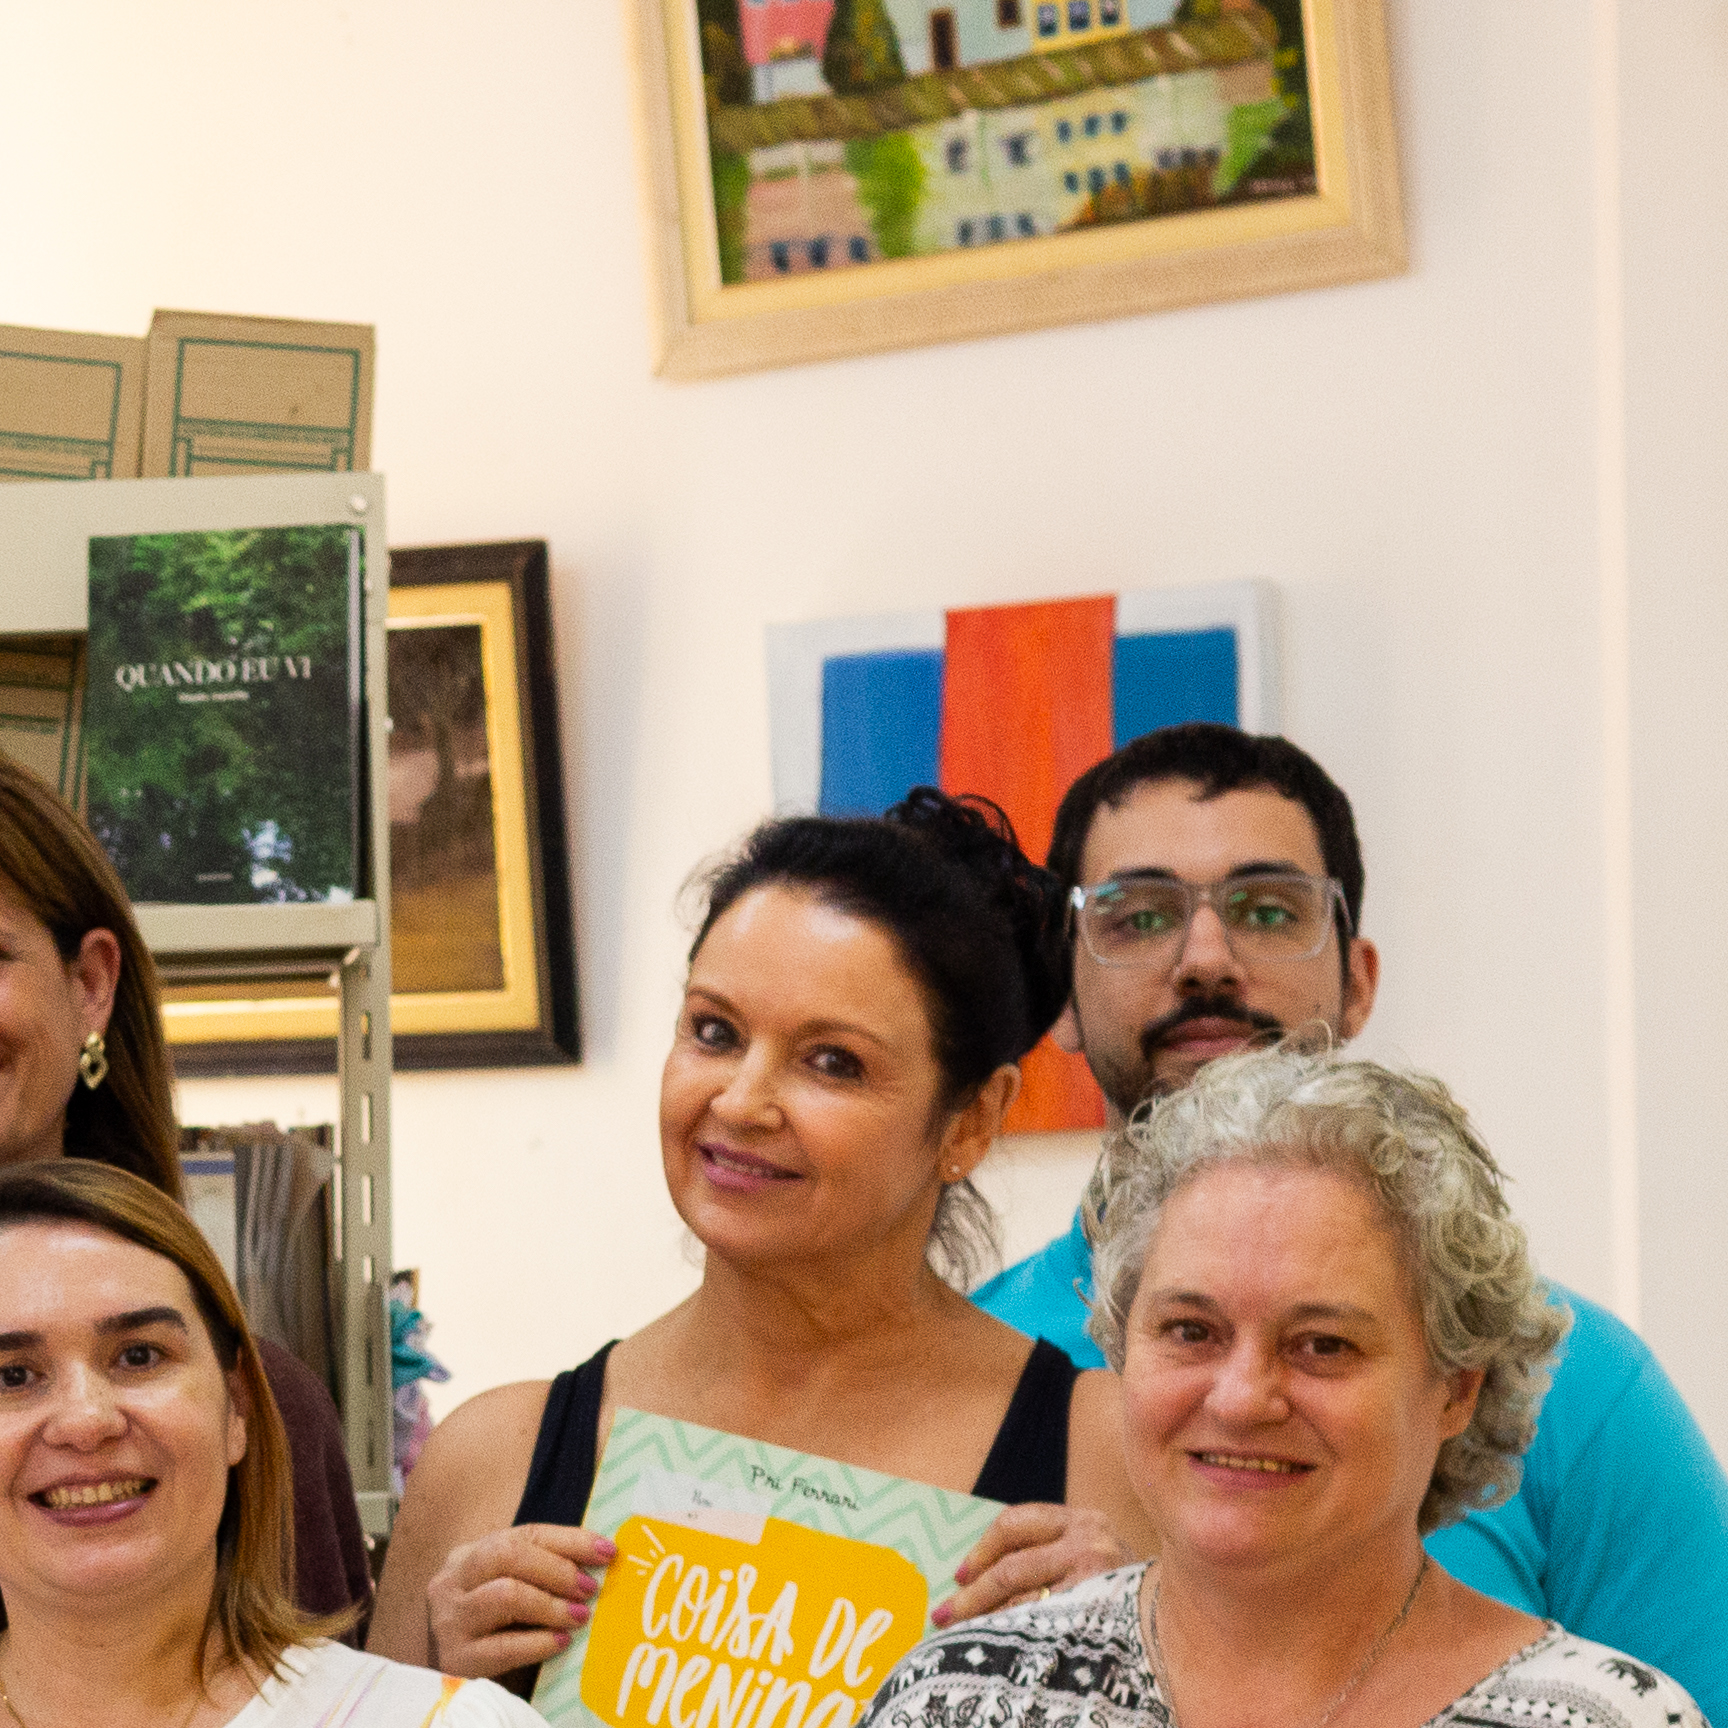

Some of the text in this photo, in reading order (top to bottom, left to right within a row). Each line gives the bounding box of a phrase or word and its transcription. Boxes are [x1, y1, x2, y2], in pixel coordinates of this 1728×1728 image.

[114, 654, 312, 693] QUANDO EU VI
[751, 1464, 782, 1491] Pri
